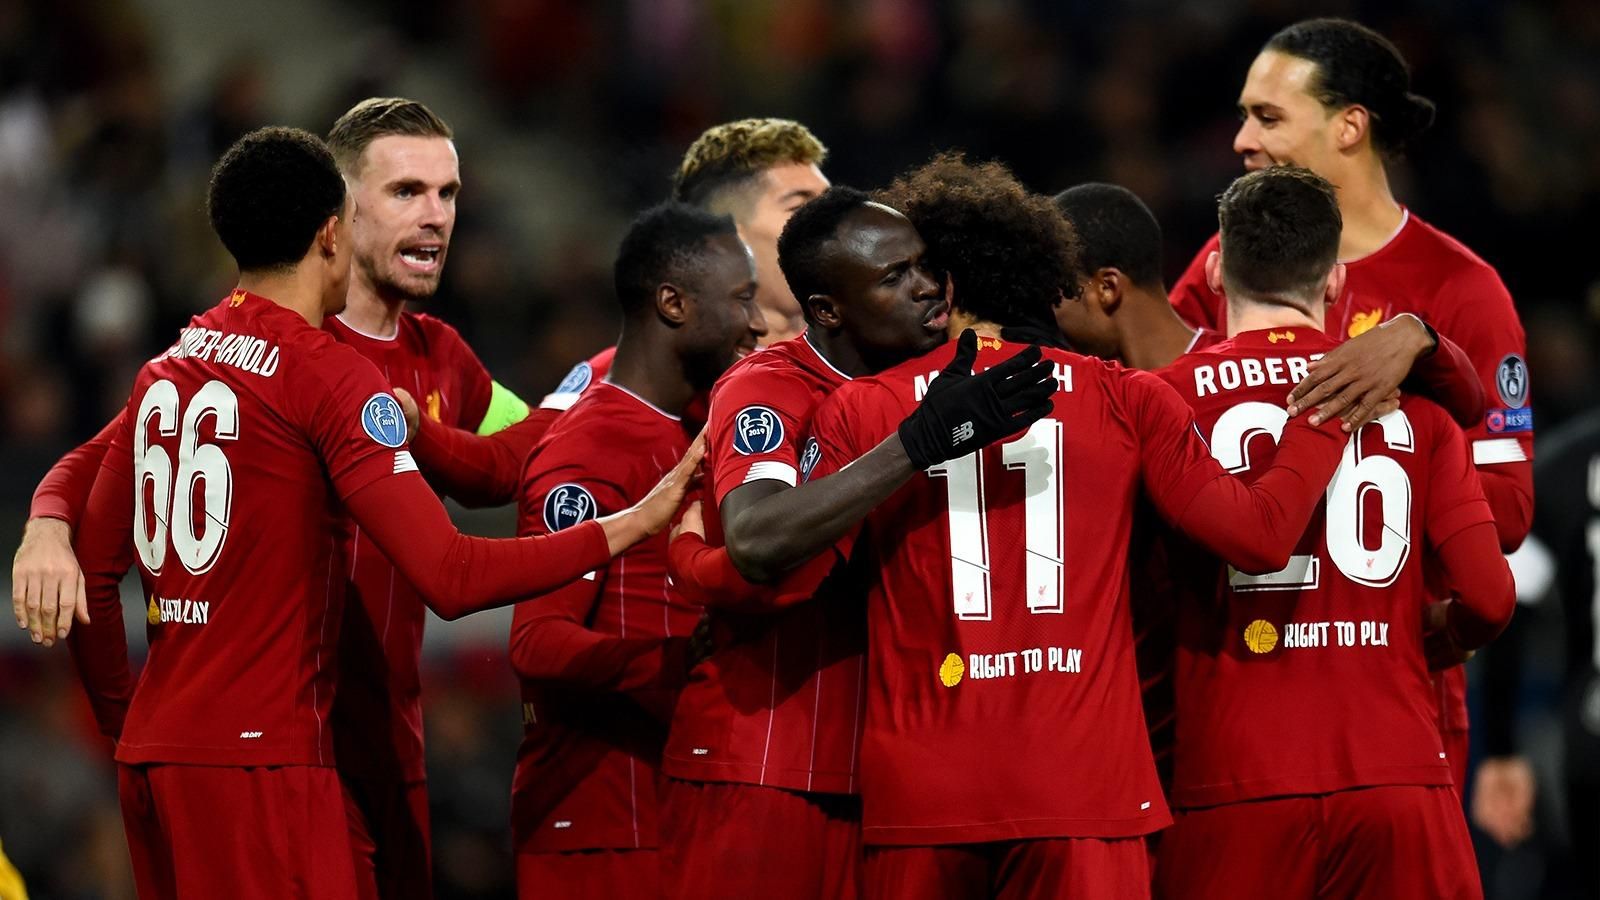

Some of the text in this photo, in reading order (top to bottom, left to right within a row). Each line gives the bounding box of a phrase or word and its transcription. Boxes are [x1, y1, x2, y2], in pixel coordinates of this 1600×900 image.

[1194, 353, 1326, 397] ROBER
[747, 427, 766, 437] 2019
[133, 379, 240, 576] 66
[924, 417, 1065, 621] 11
[1284, 621, 1331, 648] RIGHT
[1333, 620, 1356, 647] TO
[969, 646, 1082, 680] RIGHT TO PLAY
